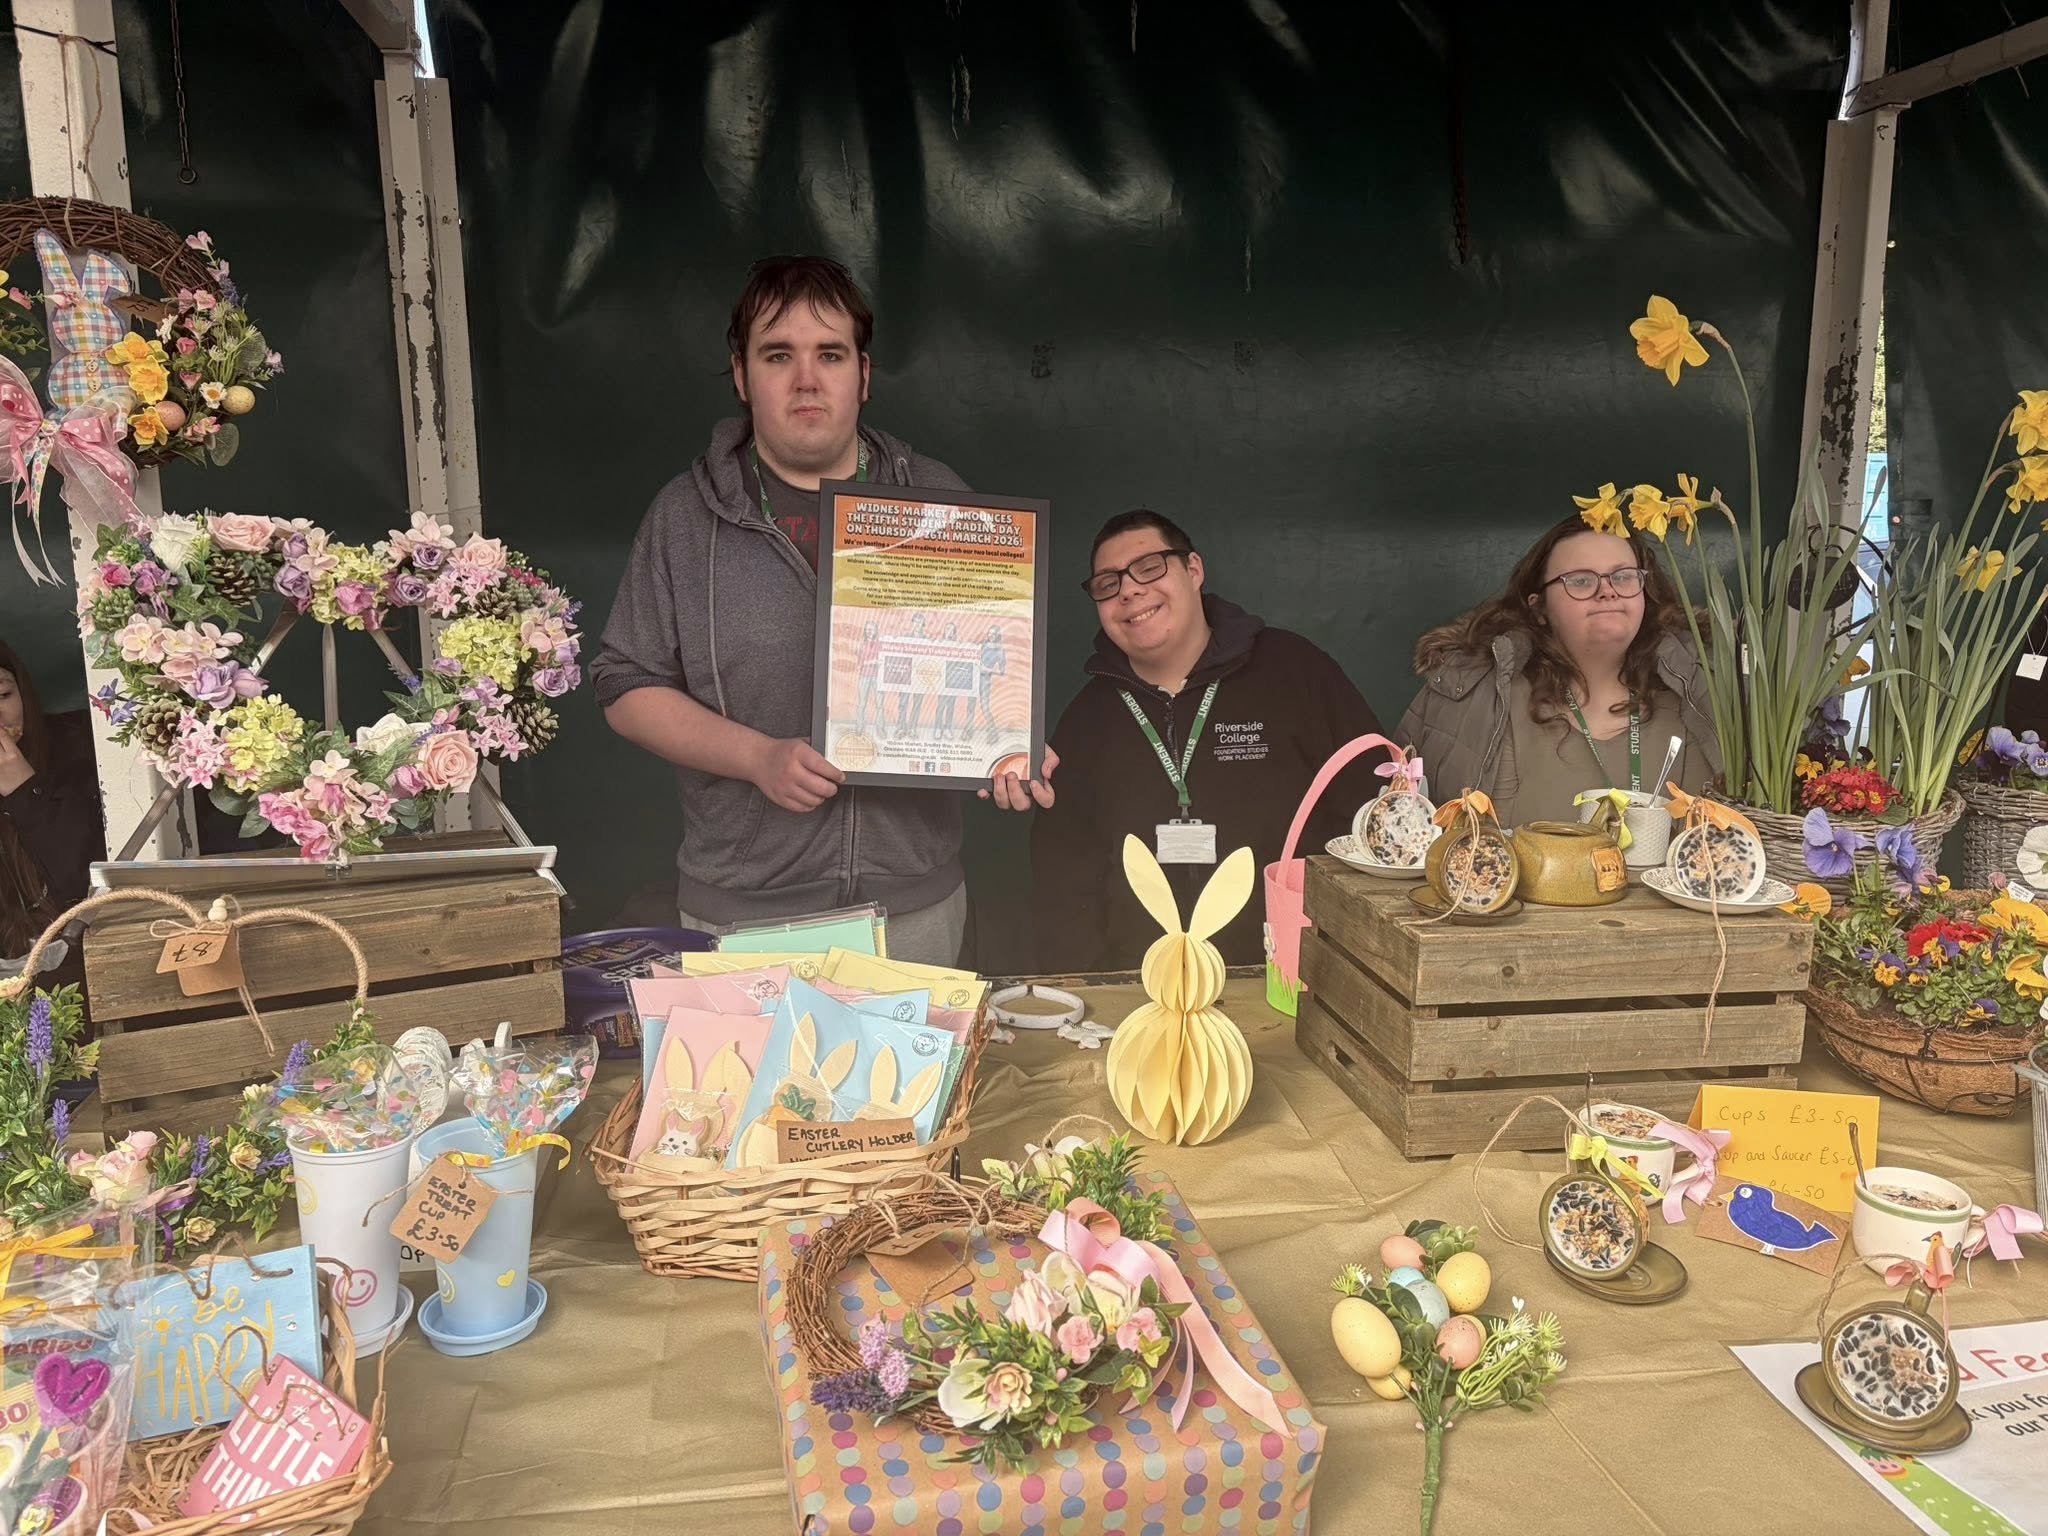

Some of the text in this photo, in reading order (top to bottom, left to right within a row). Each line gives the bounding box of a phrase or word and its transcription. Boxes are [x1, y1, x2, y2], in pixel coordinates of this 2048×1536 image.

[847, 512, 1021, 537] THE FIFTH STUDENT TRADING DAY
[856, 502, 1013, 524] WIDNES MARKET ANNOUNCES
[846, 524, 862, 535] ON
[864, 525, 921, 539] THURSDAY
[952, 532, 992, 545] MARCH
[993, 536, 1024, 548] 2026!
[1121, 691, 1148, 726] STUDENT
[1197, 682, 1218, 719] TUDENT
[1214, 721, 1264, 733] Riverside
[1219, 733, 1260, 744] College
[1630, 714, 1640, 755] STUDENT
[1153, 741, 1180, 782] STUDENT
[1719, 1105, 1766, 1126] Cups
[787, 1127, 841, 1141] EASTER
[805, 1132, 916, 1153] CUTLERY HOLDER
[1717, 1151, 1739, 1164] up
[1745, 1150, 1766, 1163] and
[1771, 1144, 1814, 1163] Saucer
[426, 1188, 472, 1221] TREAT
[427, 1175, 477, 1213] EASTER
[1982, 1400, 2031, 1420] you
[2005, 1419, 2046, 1436] our
[228, 1394, 335, 1488] LITTLE
